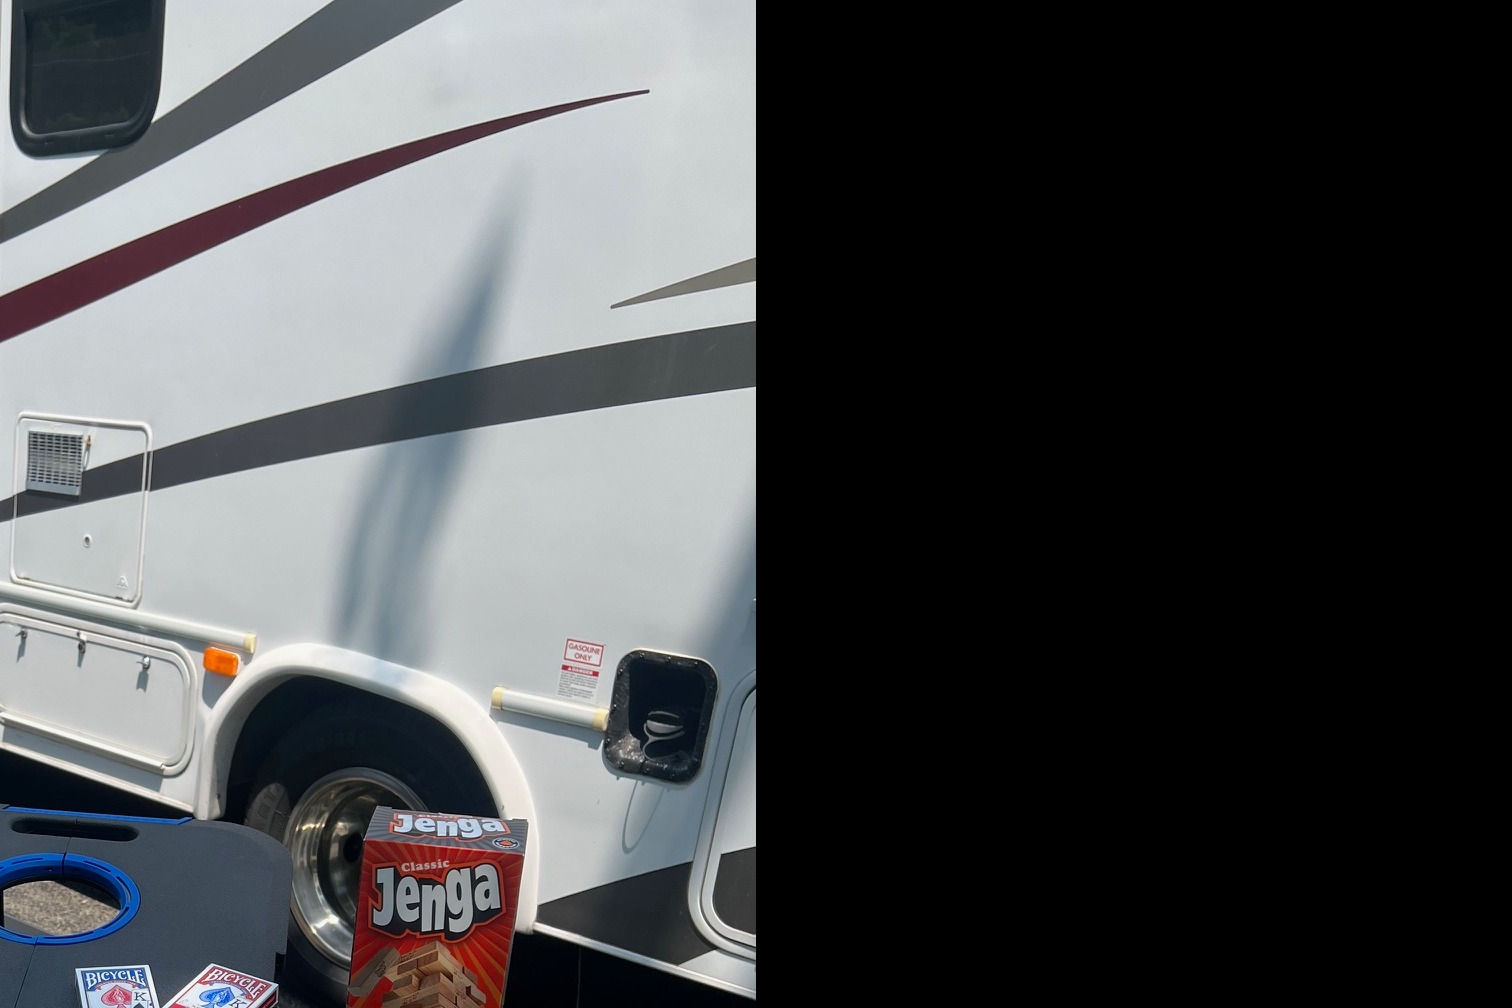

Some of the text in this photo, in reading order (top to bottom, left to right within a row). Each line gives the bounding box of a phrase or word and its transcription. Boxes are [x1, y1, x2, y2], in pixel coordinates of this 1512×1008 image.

[568, 643, 600, 655] GASOLINE
[574, 653, 592, 661] ONLY
[394, 814, 506, 838] Jenga
[401, 859, 450, 872] Classic
[373, 864, 501, 933] Jenga
[85, 970, 146, 989] BICYCLE
[202, 968, 267, 999] BICYCLE
[134, 992, 147, 1001] K
[229, 999, 247, 1008] K
